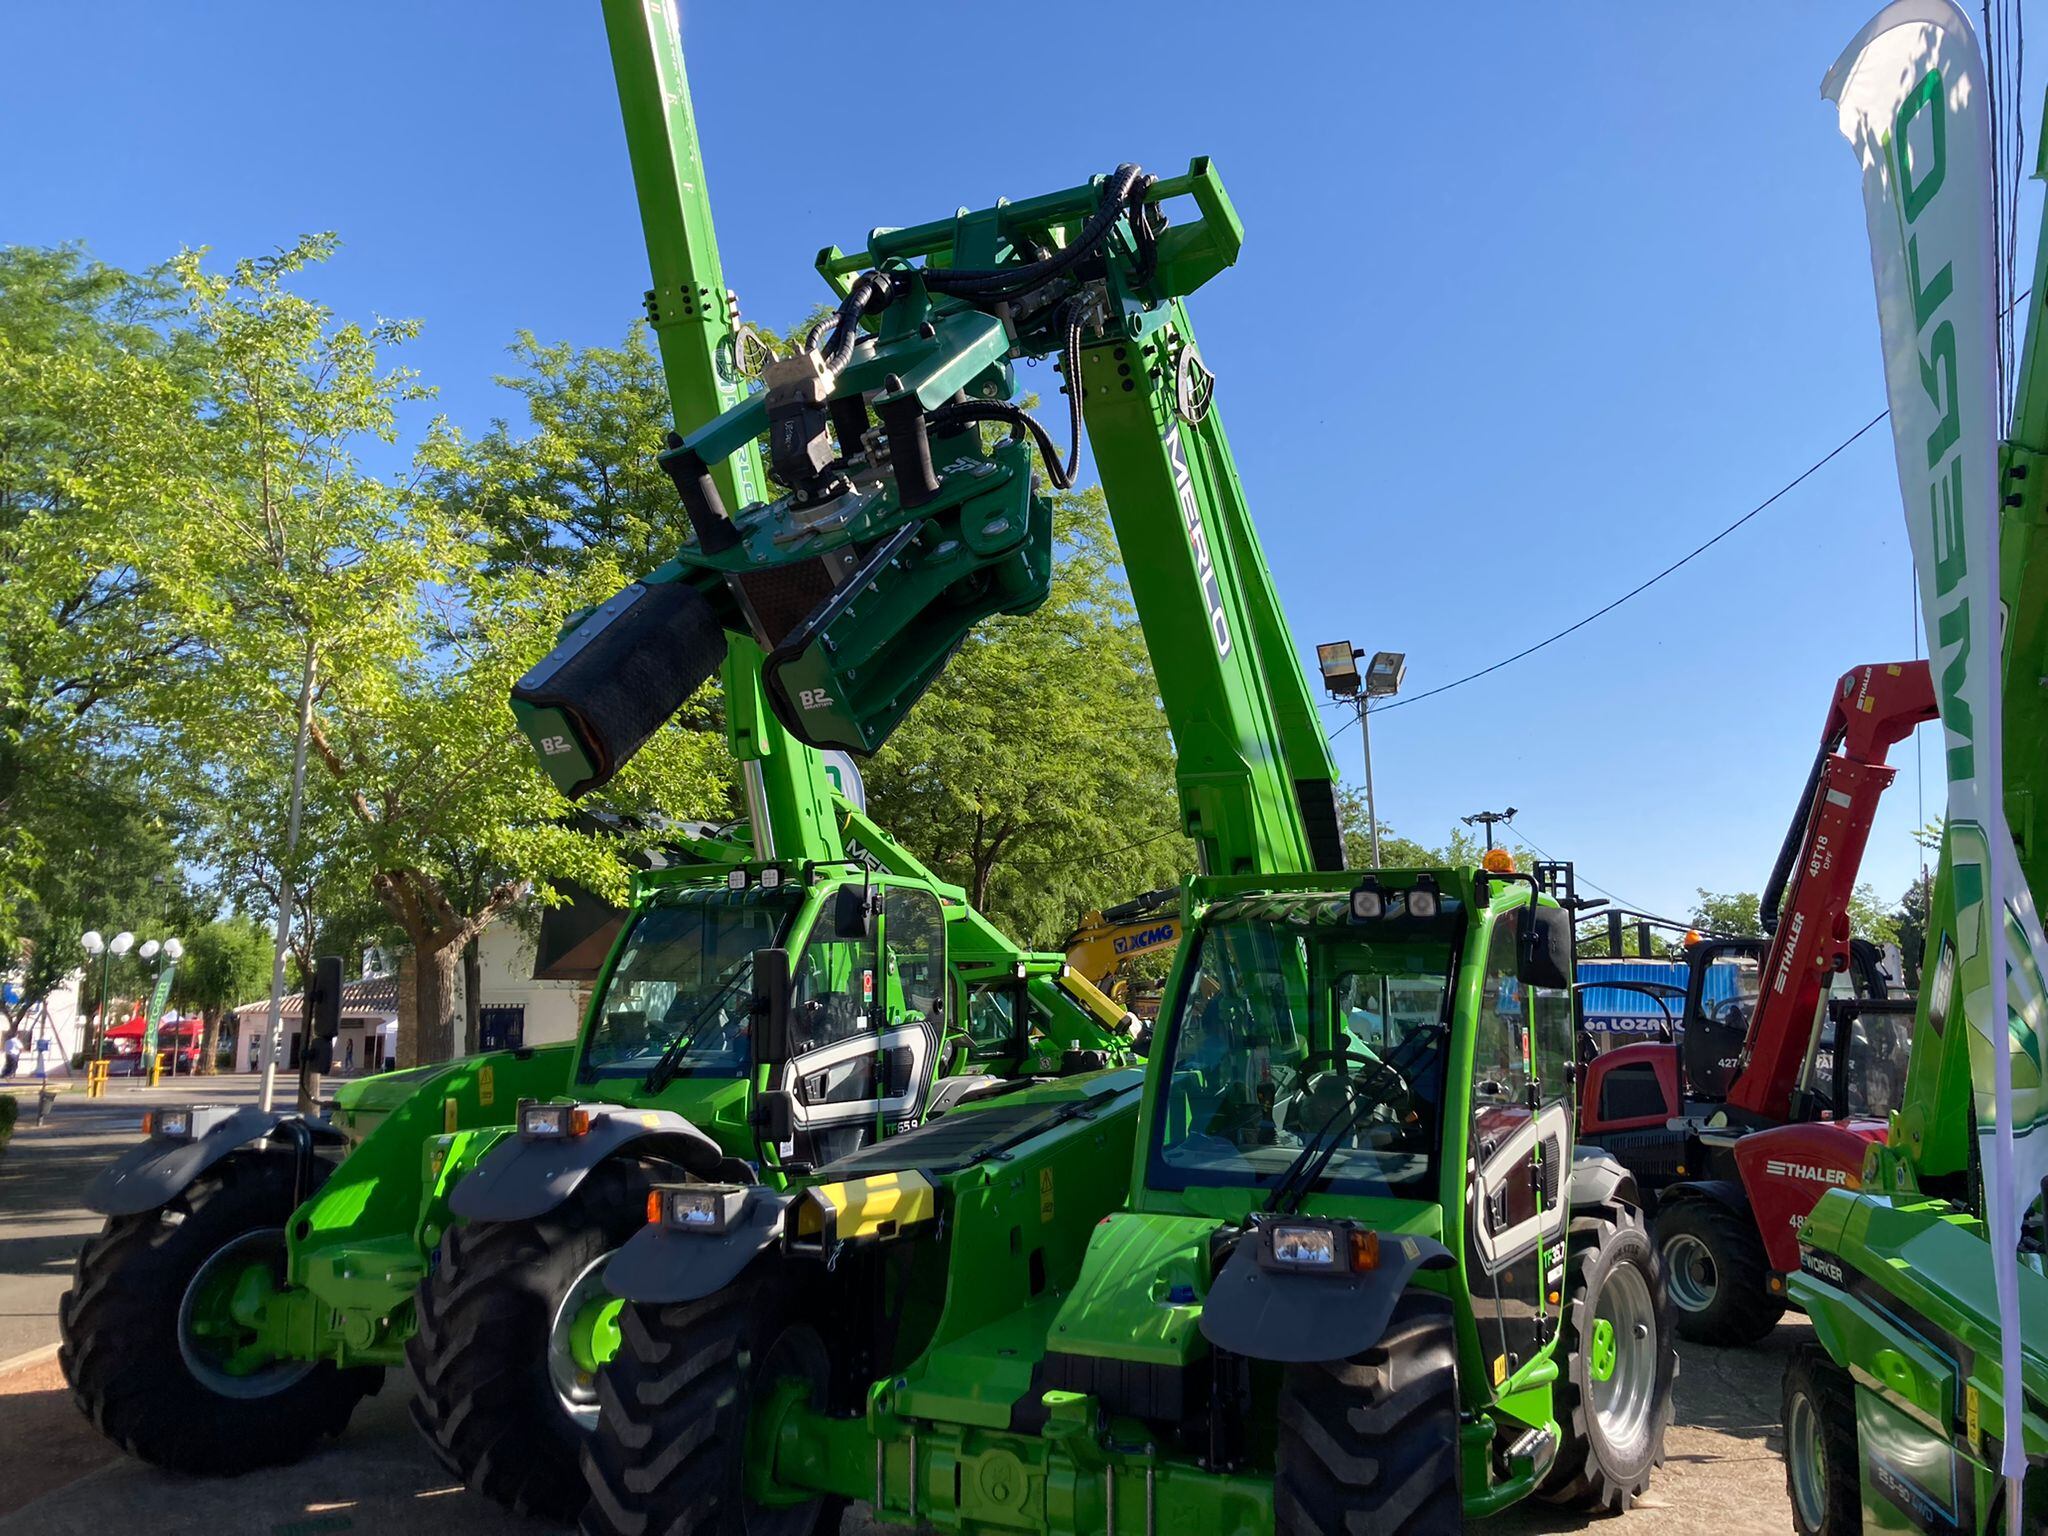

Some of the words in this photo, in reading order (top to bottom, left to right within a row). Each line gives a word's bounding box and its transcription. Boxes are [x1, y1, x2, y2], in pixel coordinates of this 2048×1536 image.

[1166, 425, 1231, 656] MERLO
[1858, 667, 1873, 703] THALER
[1809, 835, 1829, 877] 48T18
[1823, 850, 1833, 870] DPF
[1128, 924, 1174, 950] XCMG
[1779, 912, 1805, 972] THALER
[1583, 1018, 1607, 1031] ón
[1785, 1163, 1847, 1185] THALER
